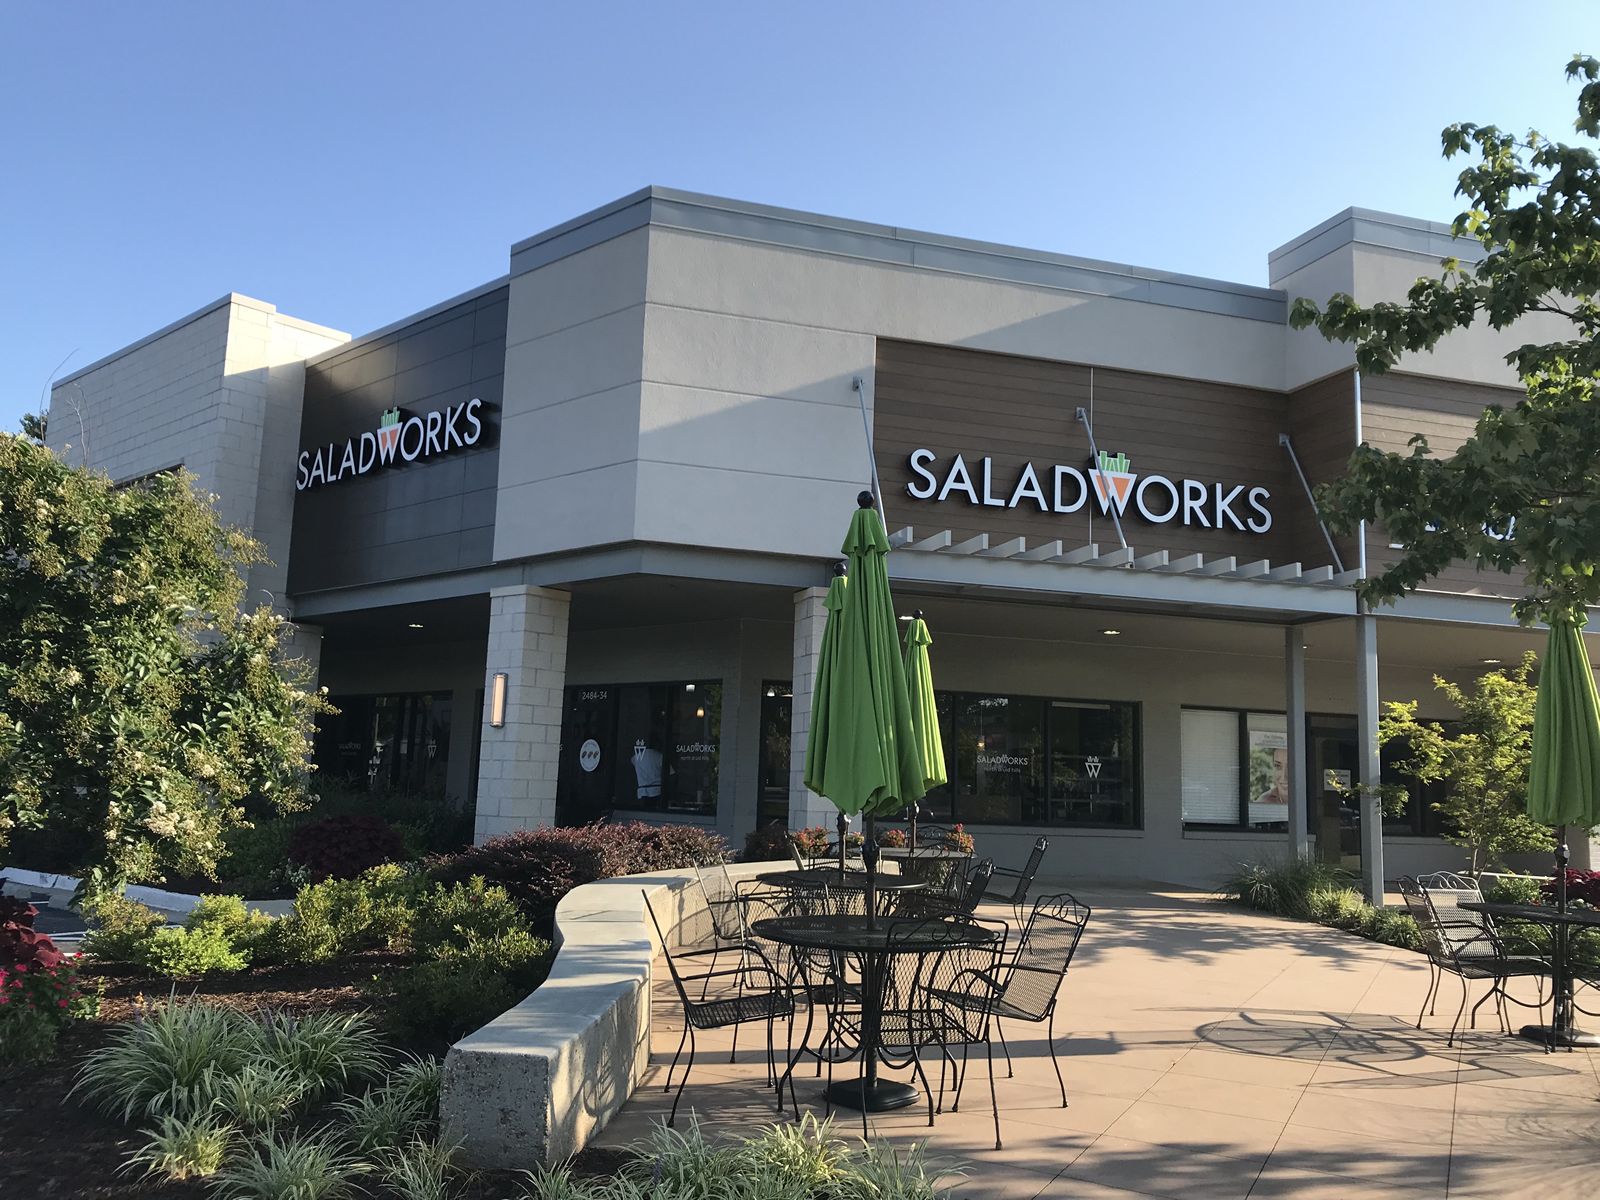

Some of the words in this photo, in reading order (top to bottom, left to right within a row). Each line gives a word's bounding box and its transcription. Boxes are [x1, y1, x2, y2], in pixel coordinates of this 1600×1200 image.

[296, 398, 482, 490] SALADWORKS
[907, 448, 1273, 534] SALADWORKS
[582, 691, 608, 700] 2484-34
[676, 742, 716, 753] SALADWORKS
[976, 754, 1029, 766] SALADWORKS
